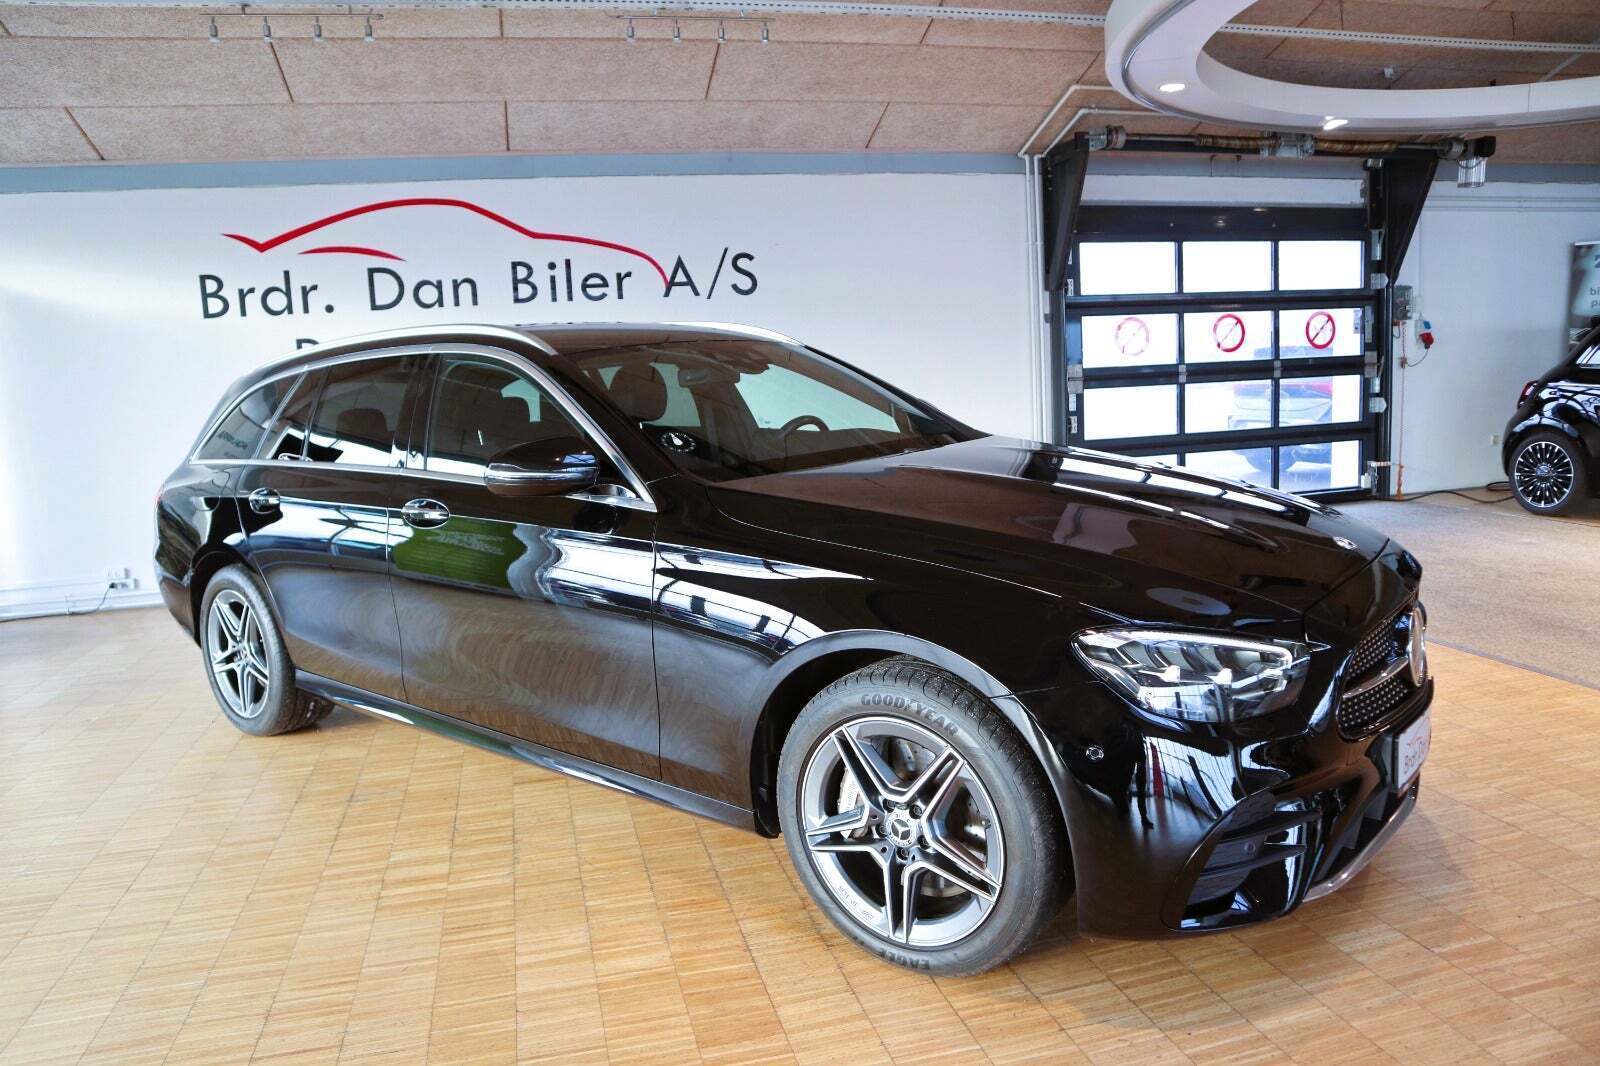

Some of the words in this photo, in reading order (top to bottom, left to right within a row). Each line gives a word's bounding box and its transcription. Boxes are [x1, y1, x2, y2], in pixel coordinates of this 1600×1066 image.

[199, 270, 334, 319] Brdr.
[367, 267, 479, 311] Dan
[510, 258, 632, 304] Biler
[663, 246, 758, 299] A/S
[861, 693, 959, 736] GOODYEAR
